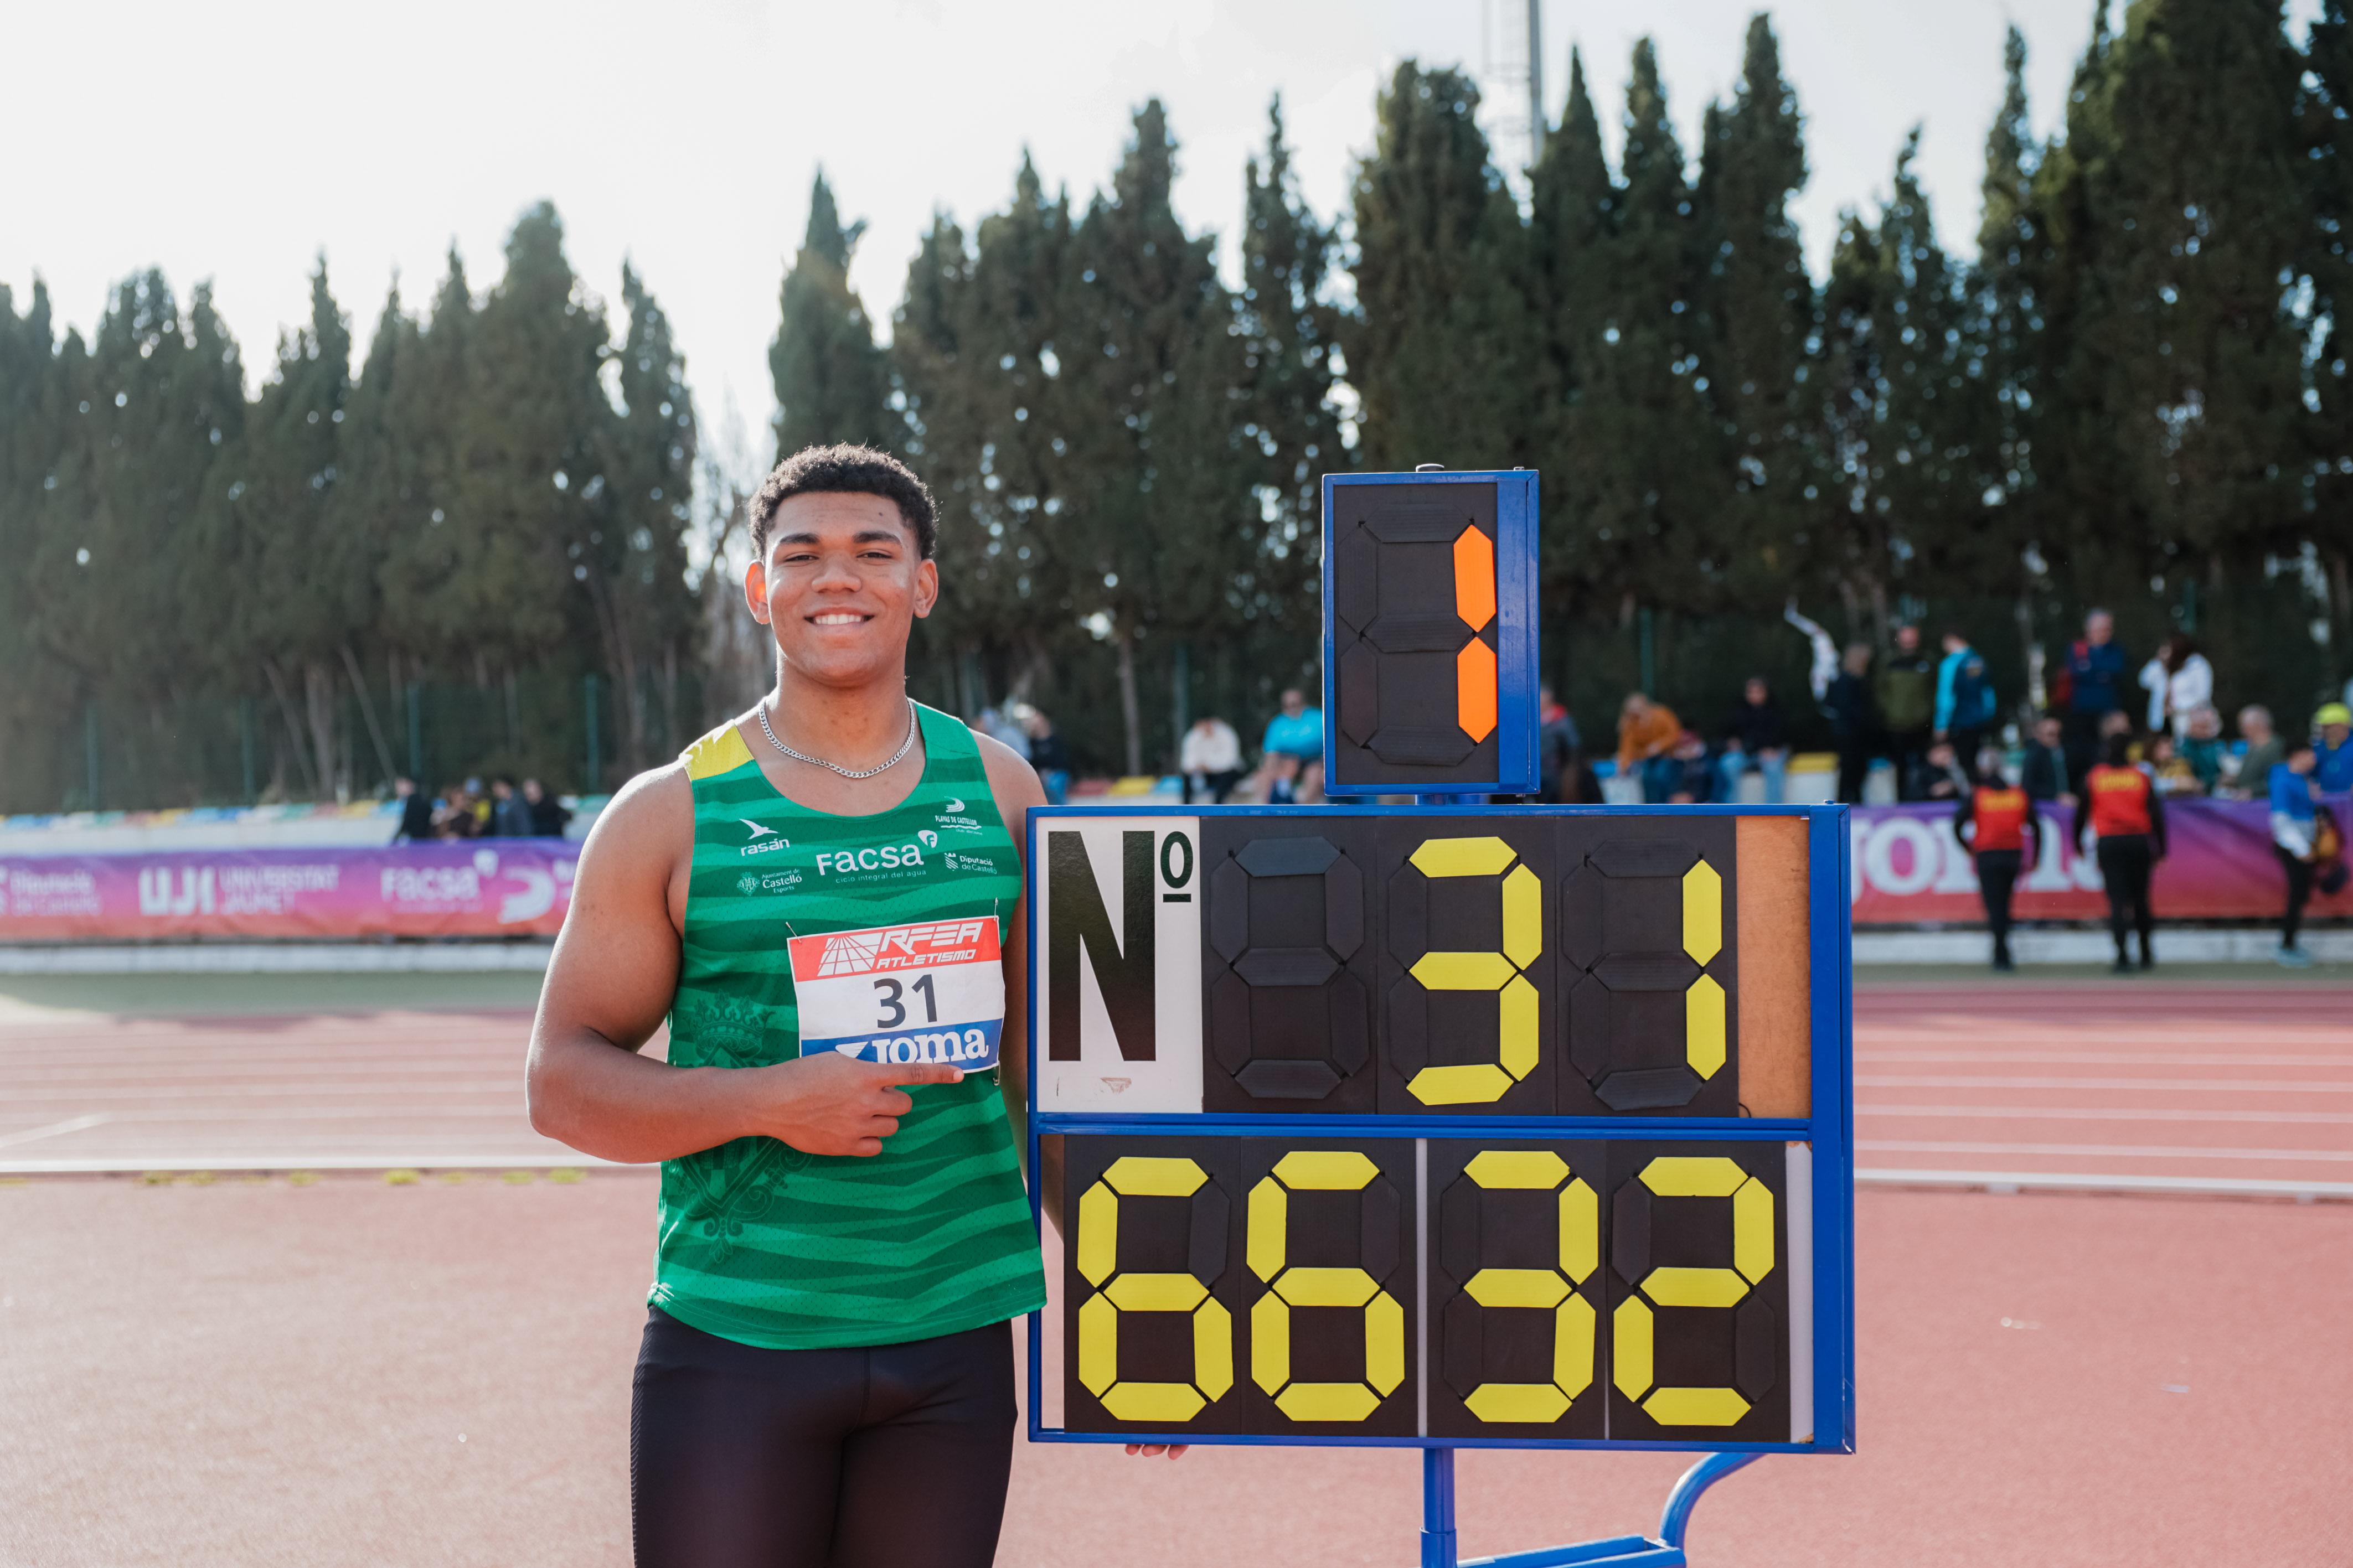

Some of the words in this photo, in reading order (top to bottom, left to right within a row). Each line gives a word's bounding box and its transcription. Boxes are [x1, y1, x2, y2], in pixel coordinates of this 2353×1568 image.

[1453, 524, 1498, 744] 1
[741, 838, 791, 857] rasán
[816, 844, 925, 876] Facsa
[959, 855, 993, 866] Diputació
[972, 864, 997, 874] Castelló
[761, 870, 792, 879] Ajuntament
[762, 874, 802, 889] Castelló
[858, 873, 888, 882] integral
[880, 922, 984, 955] RFEA
[876, 949, 977, 970] ATLETISMO
[873, 974, 937, 1029] 31
